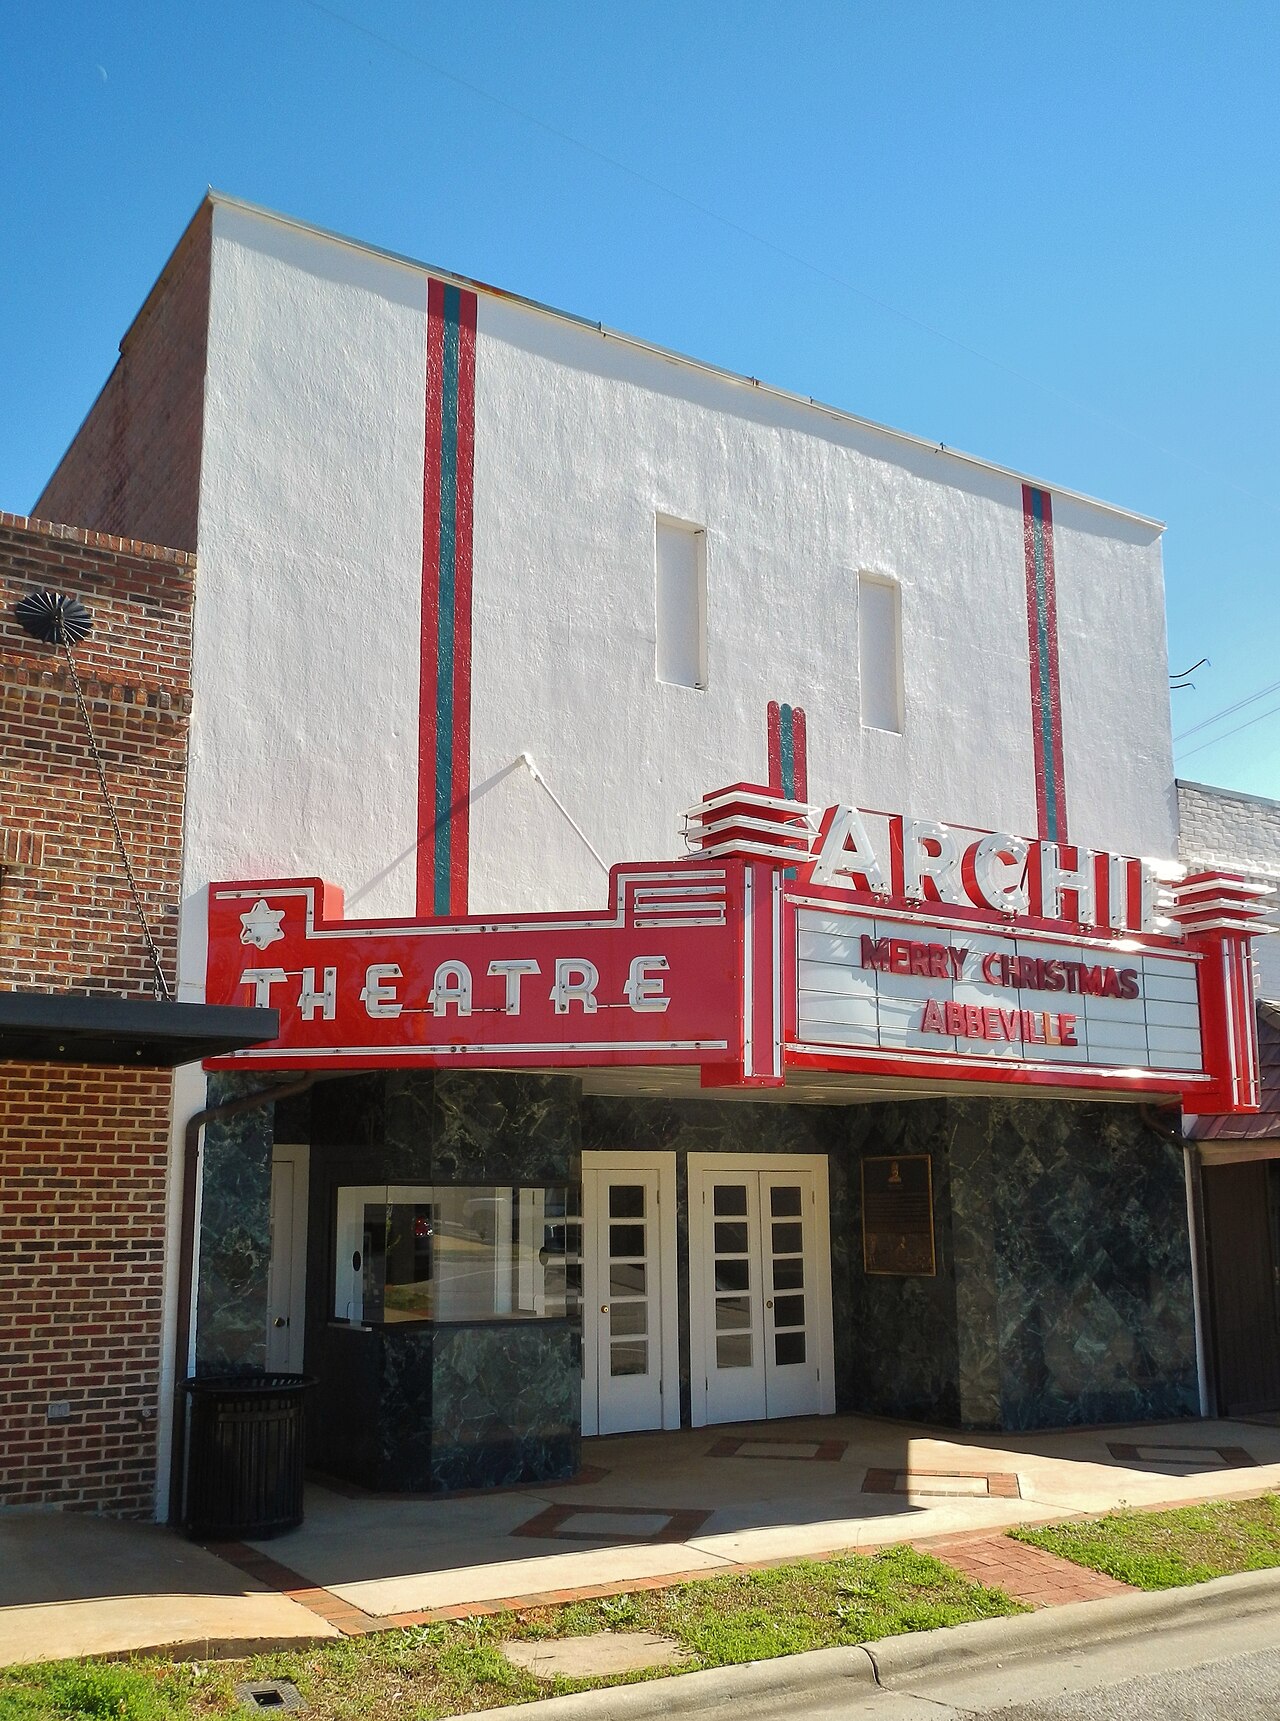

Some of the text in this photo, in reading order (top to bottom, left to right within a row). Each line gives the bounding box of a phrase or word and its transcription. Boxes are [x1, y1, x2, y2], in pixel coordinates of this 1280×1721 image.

[807, 804, 1187, 938] ARCHIE
[240, 955, 671, 1021] THEATRE
[860, 934, 1139, 999] MERRY CHRISTMAS
[921, 998, 1077, 1046] ABBEVILLE
